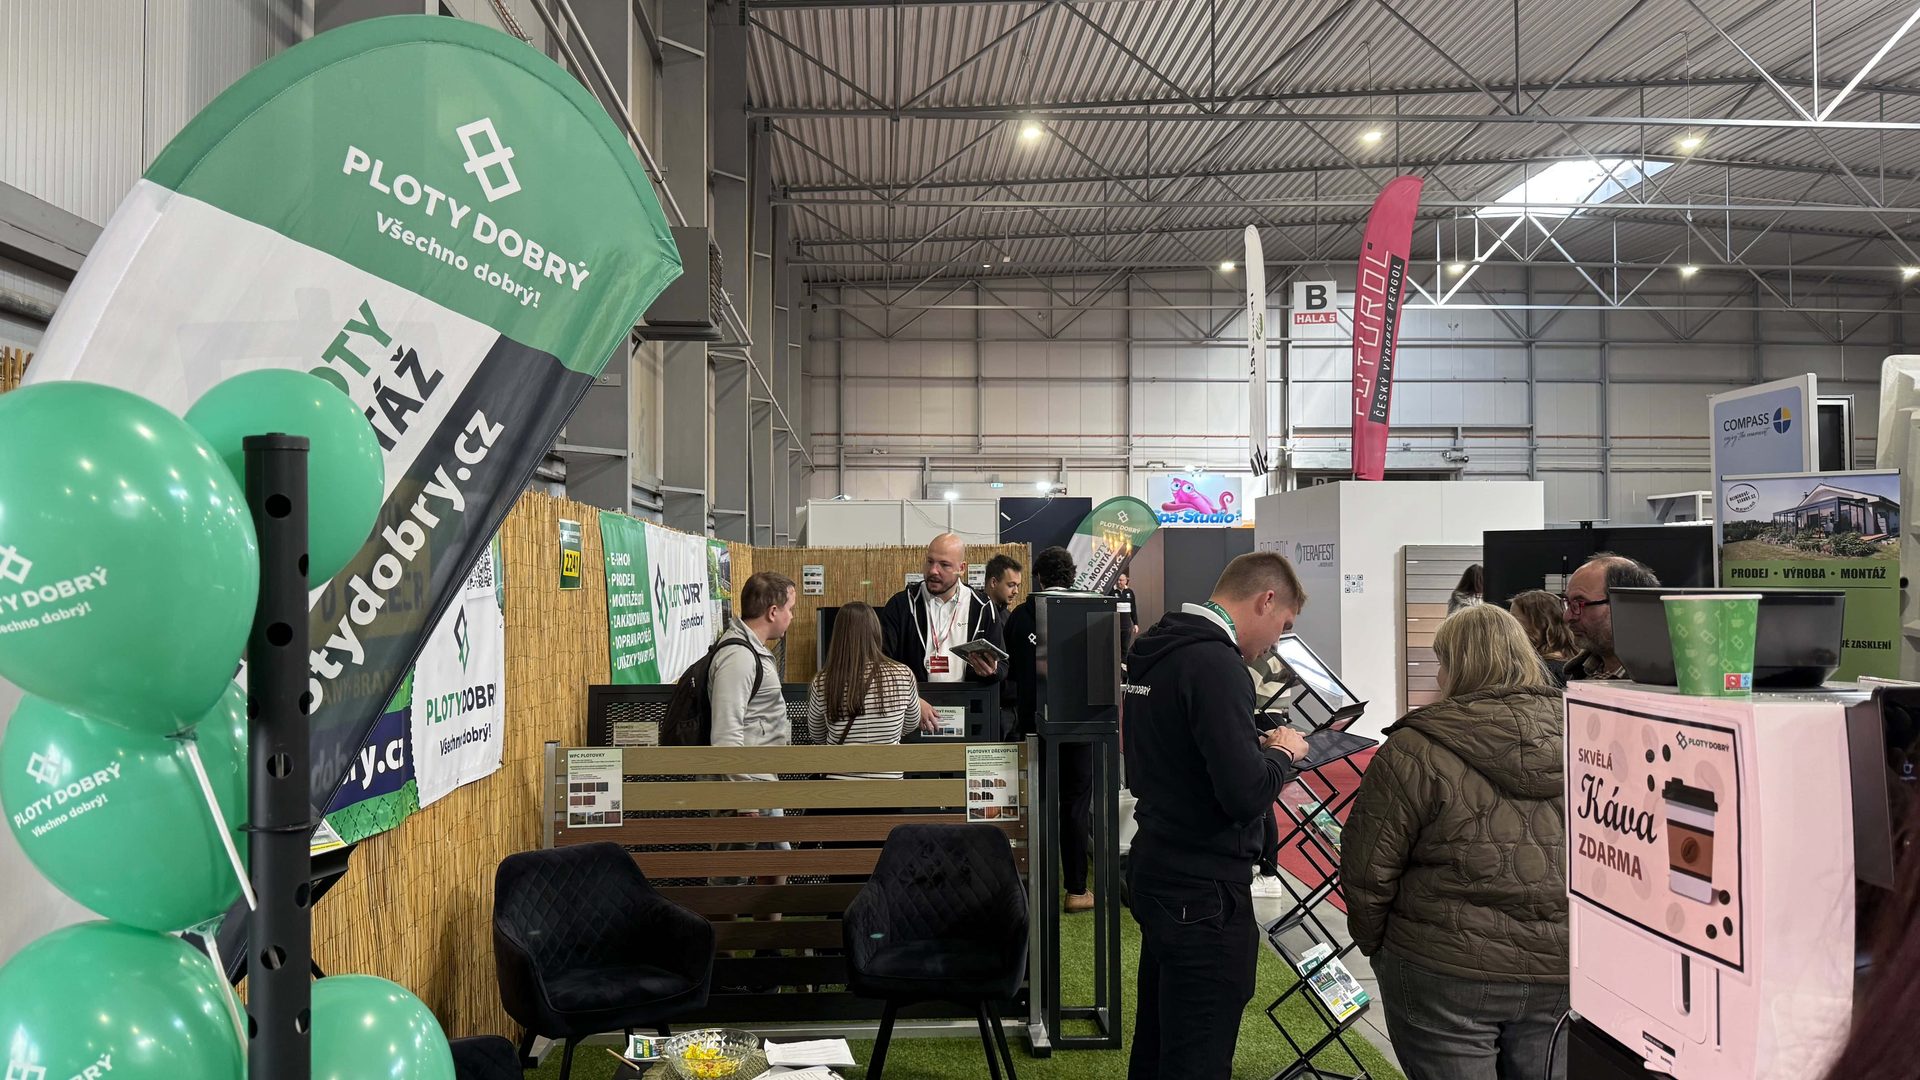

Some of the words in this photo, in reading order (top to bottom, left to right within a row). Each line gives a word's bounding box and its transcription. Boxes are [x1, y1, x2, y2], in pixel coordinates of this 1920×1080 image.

[342, 145, 471, 229] PLOTY
[472, 212, 590, 292] DOBRÝ
[376, 211, 469, 271] Všechno
[473, 263, 541, 309] dobrý!
[1305, 284, 1328, 310] B
[1387, 264, 1402, 310] PERGOL
[1296, 314, 1326, 323] HALA
[1328, 313, 1336, 322] 5
[1383, 316, 1393, 372] VÝROBCE
[1373, 377, 1389, 418] ČESKÝ
[1723, 412, 1769, 432] COMPASS
[1302, 543, 1335, 561] TERAFEST
[21, 565, 108, 608] DOBRÝ
[1731, 568, 1768, 579] PRODEJ
[1783, 566, 1826, 579] VÝROBA
[1840, 566, 1886, 580] MONTÁŽ
[41, 601, 92, 624] dobrý!
[1851, 639, 1892, 651] ZASKLENÍ
[426, 692, 463, 726] PLOTY
[1578, 748, 1613, 771] SKVĚLÁ
[1688, 738, 1709, 749] PLOTY
[1708, 741, 1730, 753] DOBRÝ
[13, 794, 52, 829] PLOTY
[53, 761, 121, 805] DOBRÝ
[68, 793, 109, 818] dobrý!
[1577, 773, 1658, 844] Káva
[1578, 833, 1643, 881] ZDARMA
